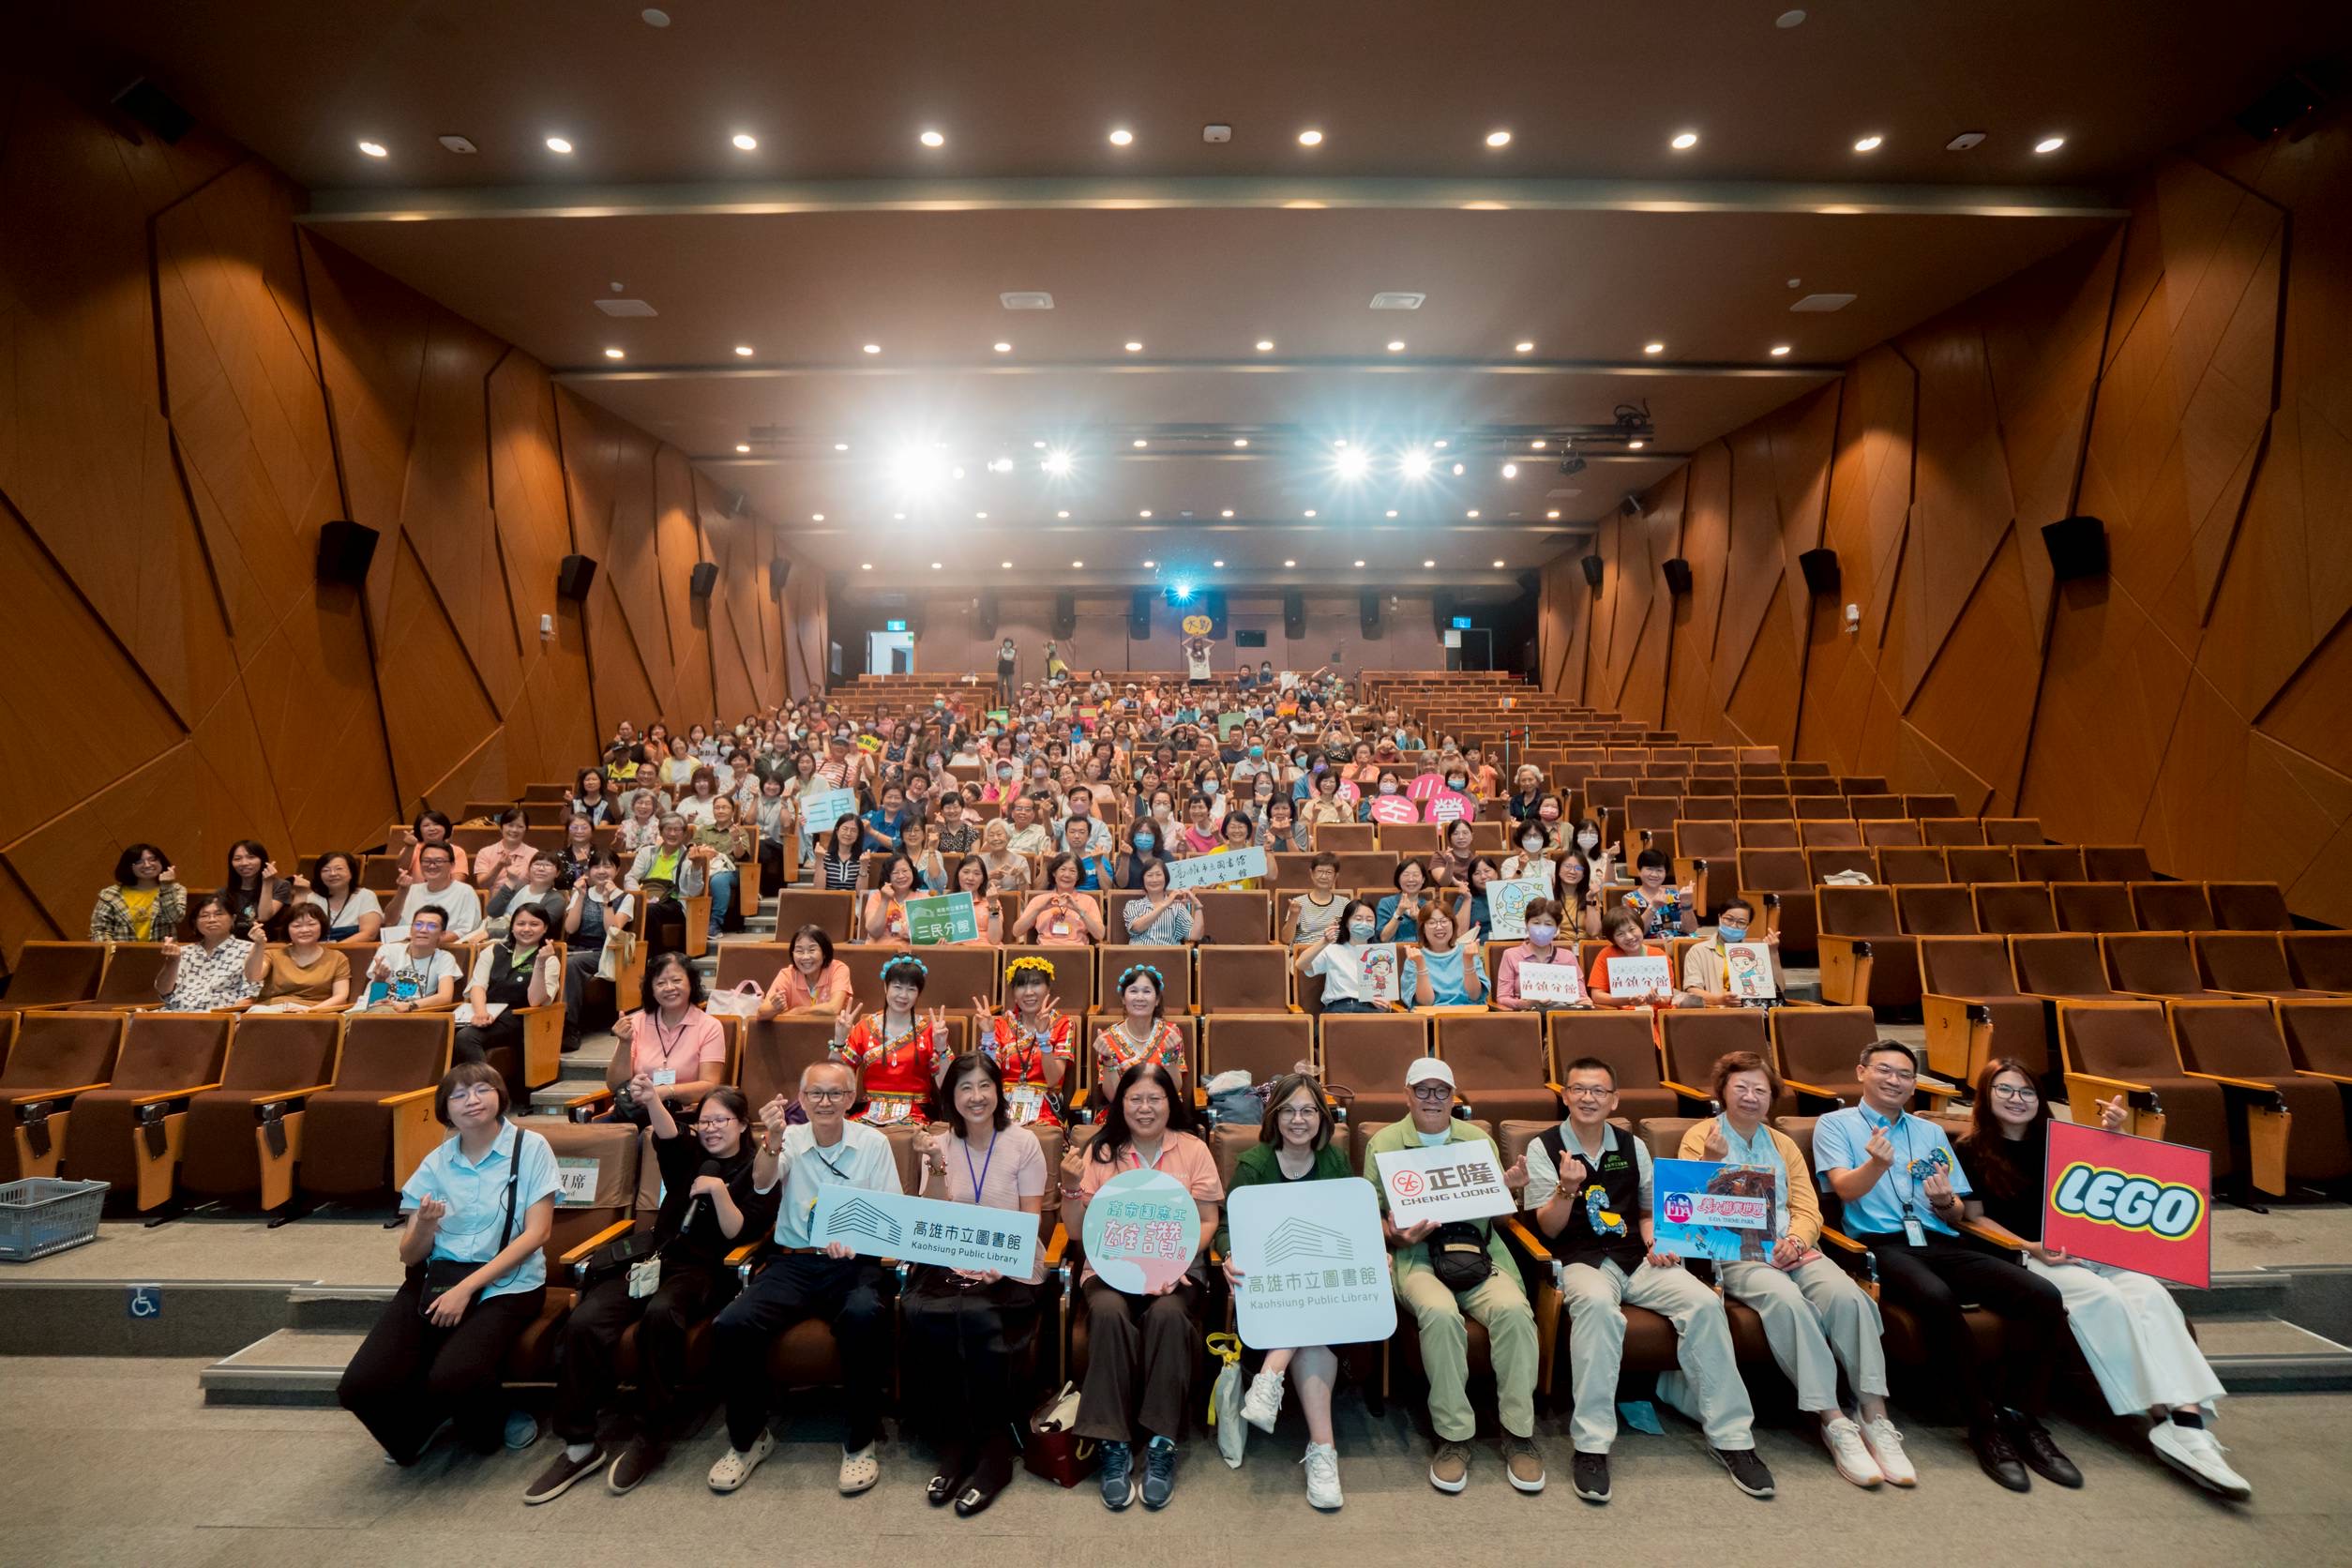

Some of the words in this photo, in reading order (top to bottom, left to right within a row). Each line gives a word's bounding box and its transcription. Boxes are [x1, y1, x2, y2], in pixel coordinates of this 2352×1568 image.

[916, 919, 971, 939] 三民分館
[1942, 1018, 1949, 1029] 3
[423, 1108, 429, 1122] 2
[1425, 1162, 1496, 1191] 正隆
[1400, 1193, 1450, 1206] CHENG
[1453, 1185, 1500, 1199] LOONG
[2054, 1164, 2201, 1238] LEGO
[912, 1219, 1022, 1251] 高雄市立圖書館
[912, 1241, 957, 1256] Kaohsiung
[958, 1247, 986, 1259] Public
[987, 1251, 1018, 1265] Library
[1247, 1266, 1378, 1294] 高雄市立圖書館
[1250, 1297, 1305, 1310] Kaohsiung
[1307, 1293, 1340, 1305] Public
[1342, 1291, 1380, 1304] Library
